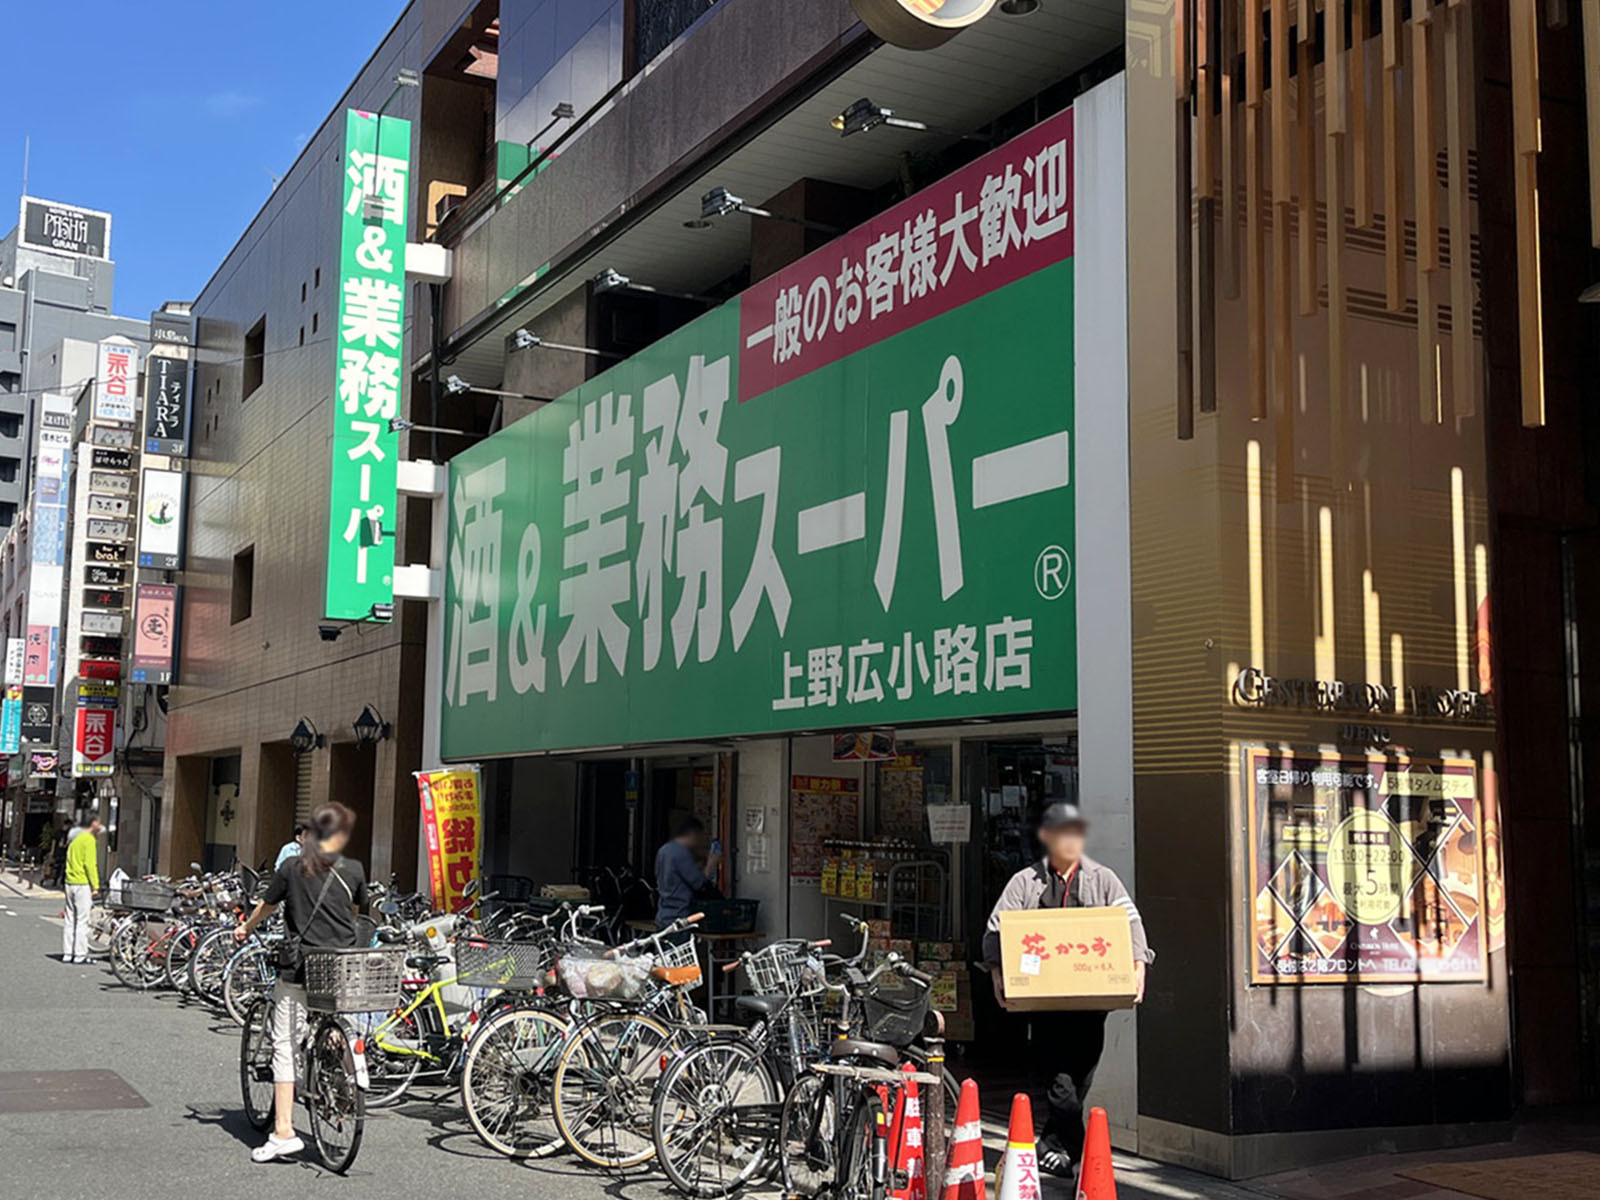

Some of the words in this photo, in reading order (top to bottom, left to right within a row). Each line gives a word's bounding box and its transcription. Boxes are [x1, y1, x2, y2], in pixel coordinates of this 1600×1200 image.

[43, 213, 88, 243] PASHA
[52, 238, 79, 250] GRAN
[746, 138, 1068, 365] 一般のお客様大歓迎
[153, 359, 172, 438] TIARA
[168, 382, 182, 428] ティアラ
[171, 443, 184, 454] 3F
[446, 353, 1069, 708] 酒&業務スーパー
[165, 557, 178, 568] 2F
[772, 617, 1034, 711] 上野広小路店
[1021, 932, 1112, 960] 花かつお
